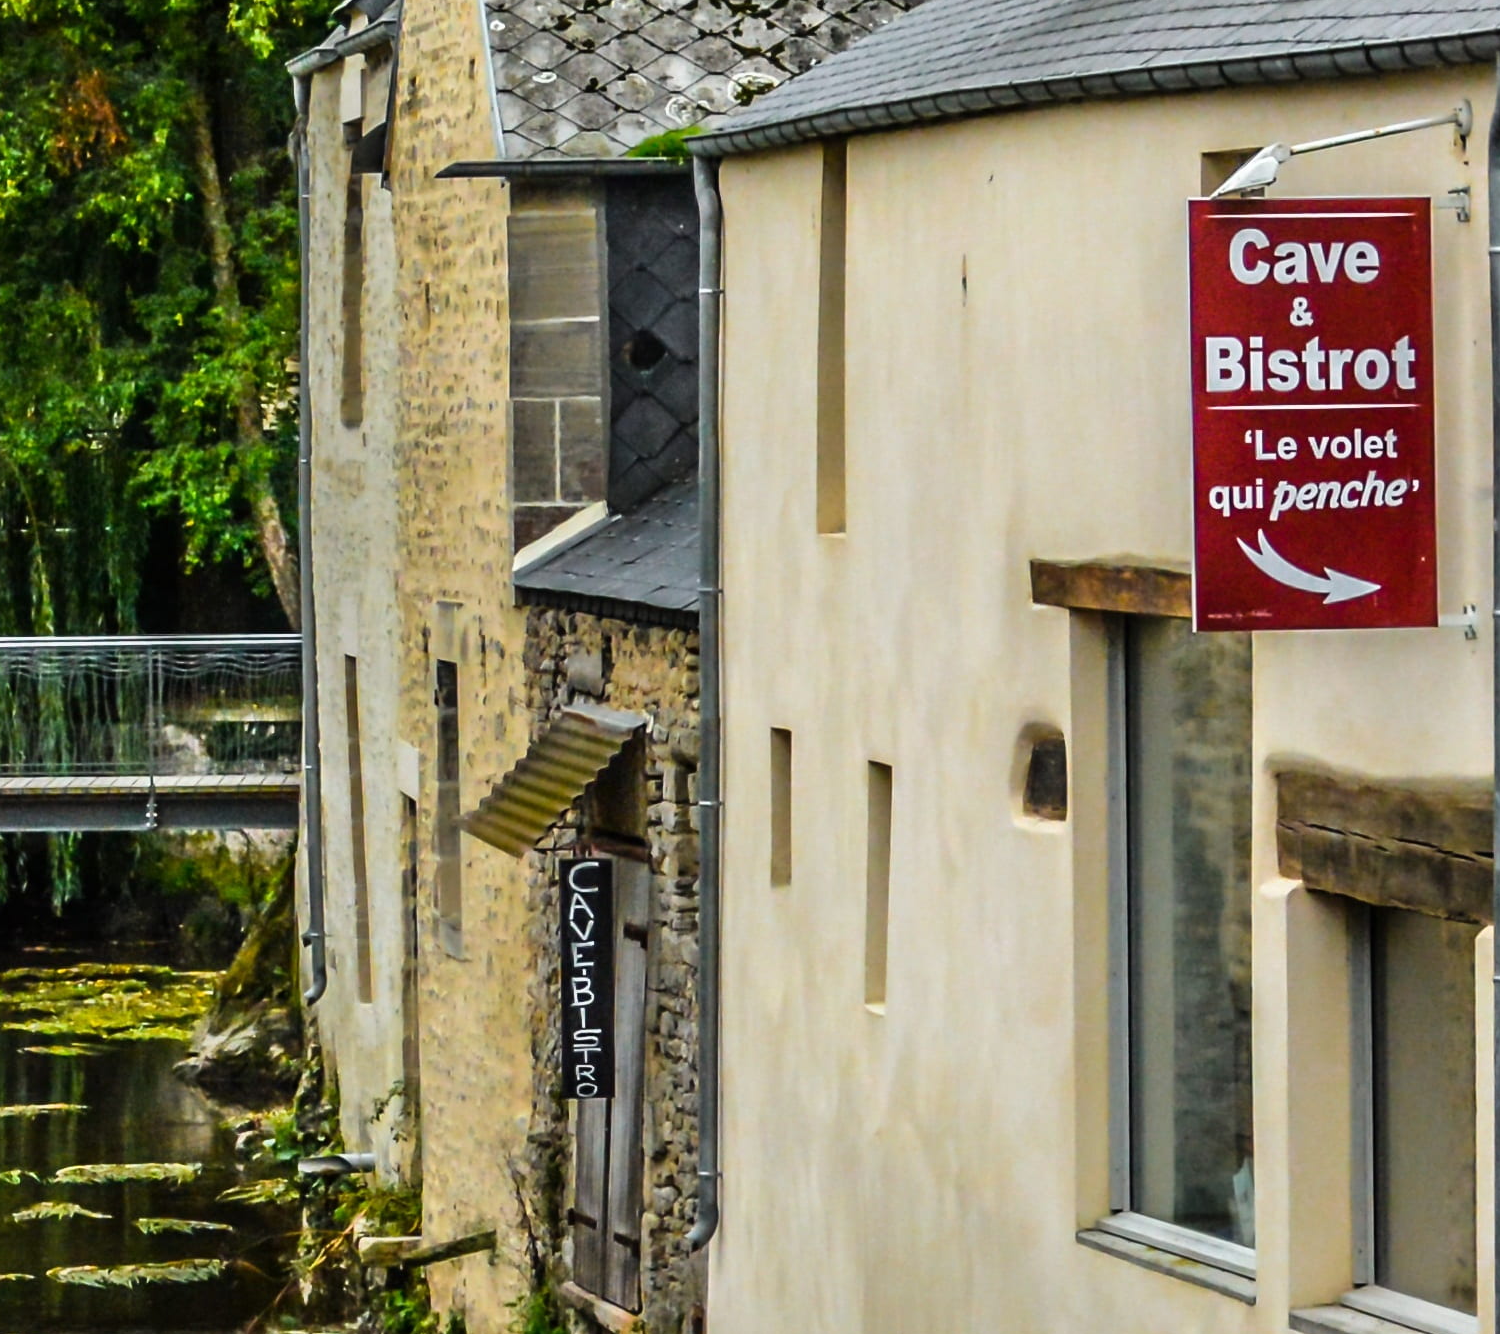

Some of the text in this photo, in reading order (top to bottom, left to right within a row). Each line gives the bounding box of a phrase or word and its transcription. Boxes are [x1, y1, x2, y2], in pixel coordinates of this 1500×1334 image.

[1229, 228, 1380, 285] Cave
[1289, 297, 1314, 327] &
[1205, 334, 1416, 393] Bistrot
[1308, 428, 1399, 460] volet
[1208, 478, 1265, 517] qui
